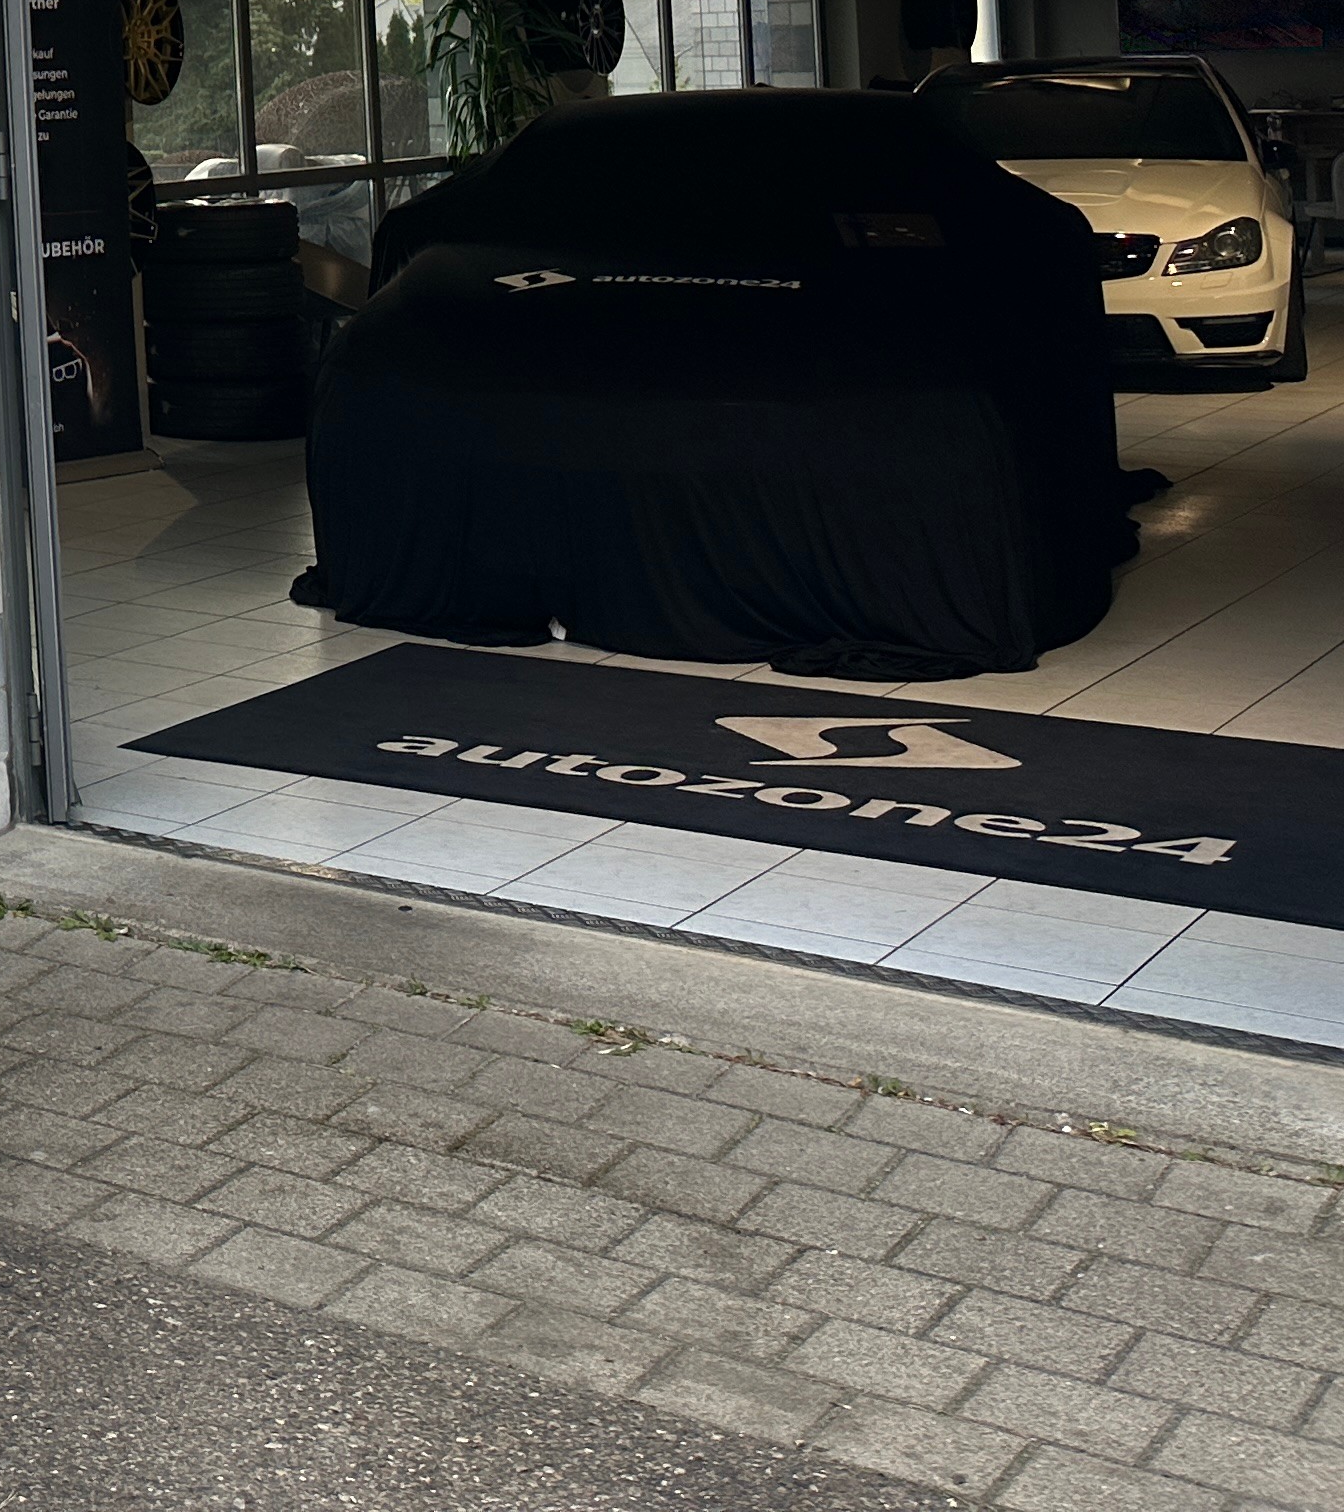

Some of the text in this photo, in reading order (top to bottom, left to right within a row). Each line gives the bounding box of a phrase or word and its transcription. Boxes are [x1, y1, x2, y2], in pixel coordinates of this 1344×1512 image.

[38, 107, 79, 121] Garantie
[592, 273, 802, 289] autozone24
[376, 735, 1238, 866] autozone24
